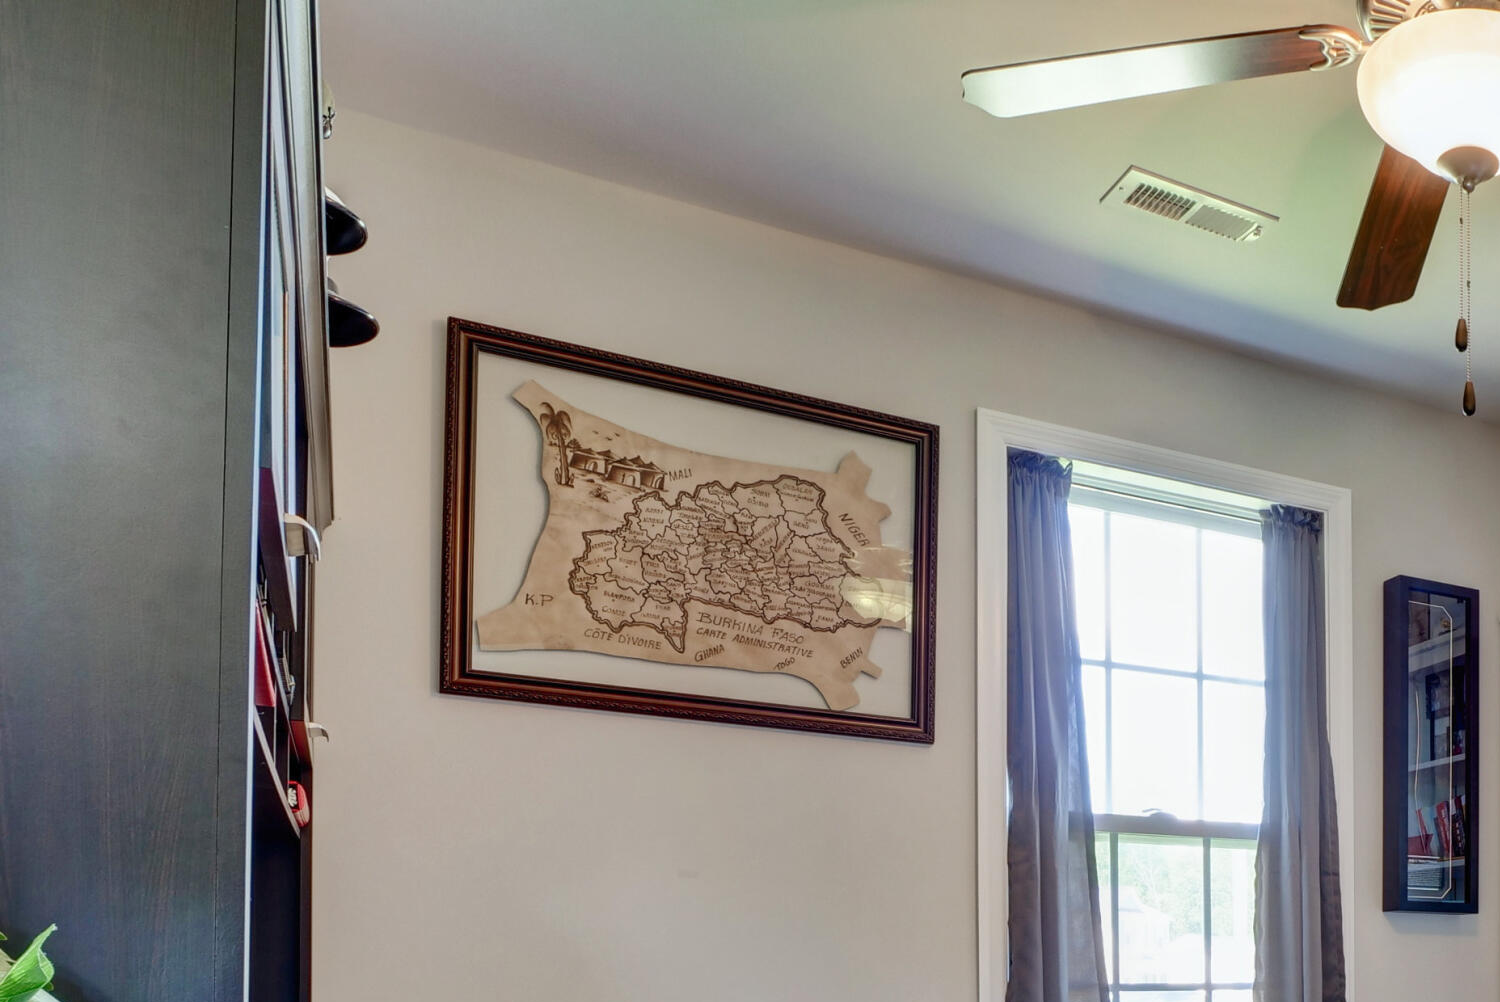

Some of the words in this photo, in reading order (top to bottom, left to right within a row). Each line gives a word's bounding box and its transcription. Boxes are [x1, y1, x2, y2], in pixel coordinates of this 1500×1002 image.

[668, 468, 693, 482] MALI
[838, 512, 871, 547] NIGER
[696, 612, 765, 636] BURKINA
[772, 627, 805, 645] FASO
[694, 643, 726, 663] GHANA
[696, 627, 728, 640] CARTE
[732, 633, 816, 659] ADMINISTRATIVE
[774, 656, 796, 671] TOGO
[840, 647, 864, 669] BENIN
